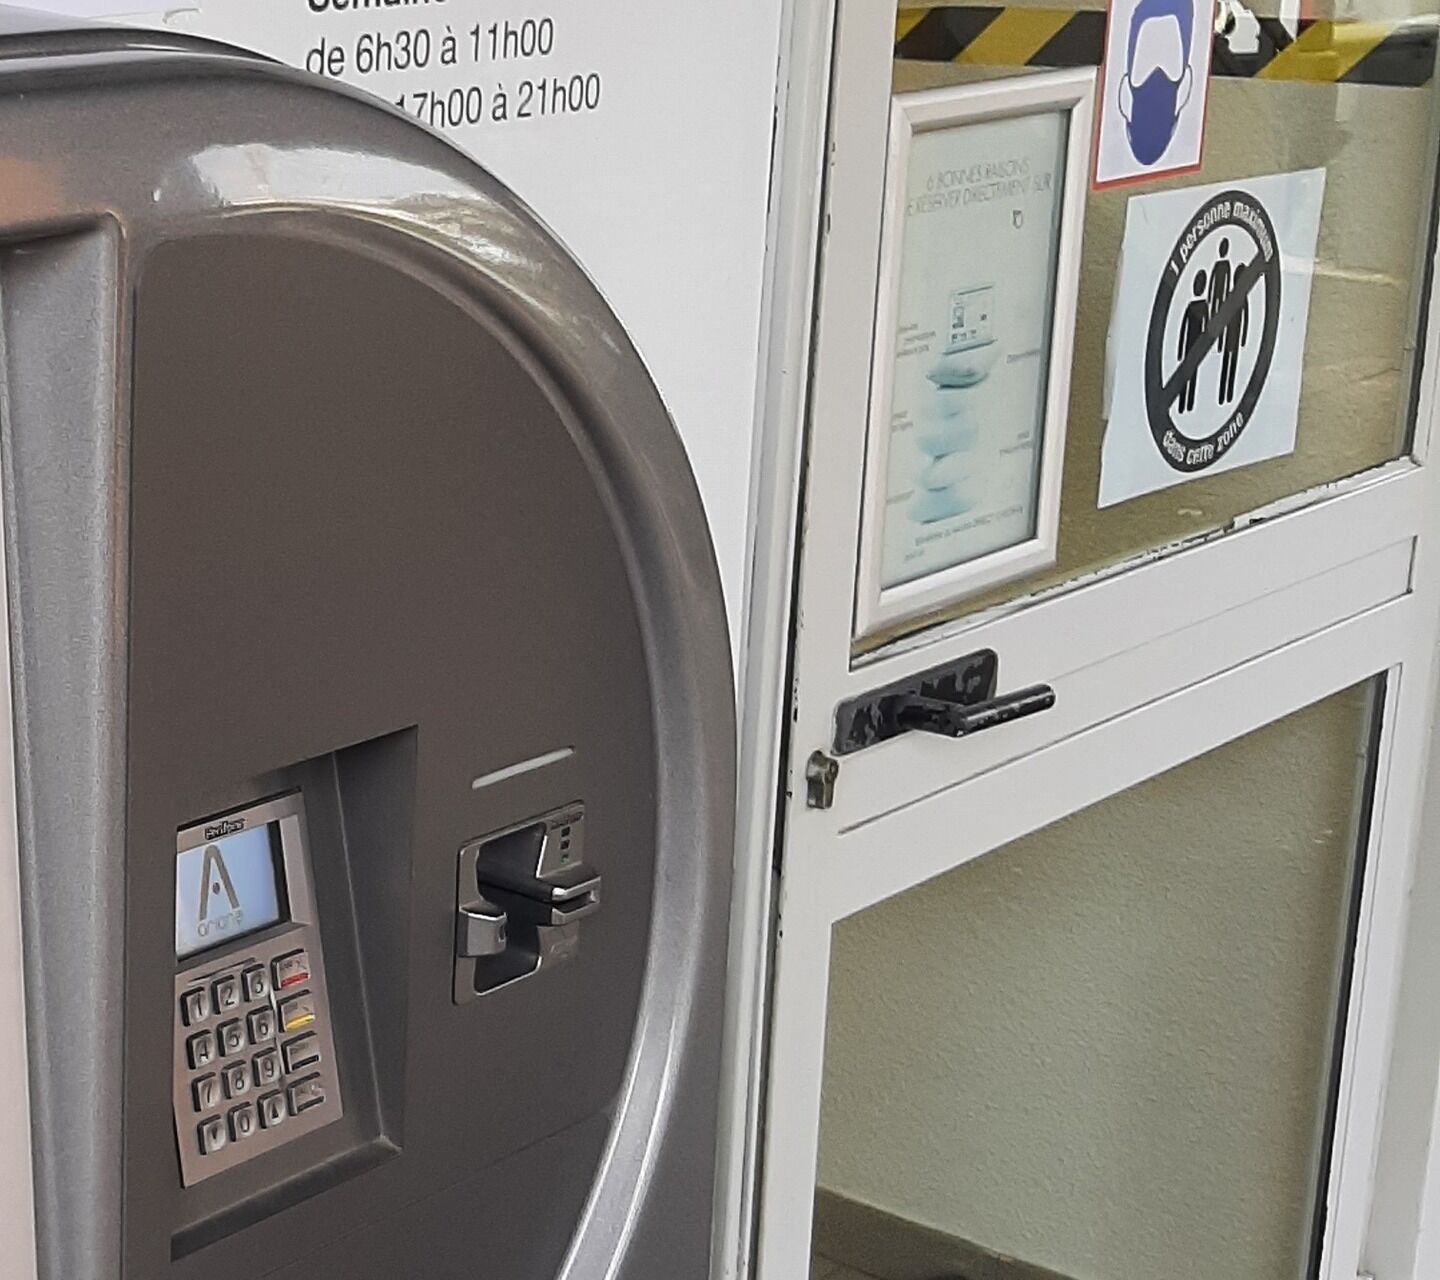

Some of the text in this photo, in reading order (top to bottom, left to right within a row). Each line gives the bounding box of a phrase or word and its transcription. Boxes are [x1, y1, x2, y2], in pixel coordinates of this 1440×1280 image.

[306, 18, 554, 76] de 6h30 à 11h00
[491, 83, 508, 121] à
[517, 73, 601, 118] 21h00
[1179, 201, 1231, 264] personne
[1217, 411, 1244, 453] zone
